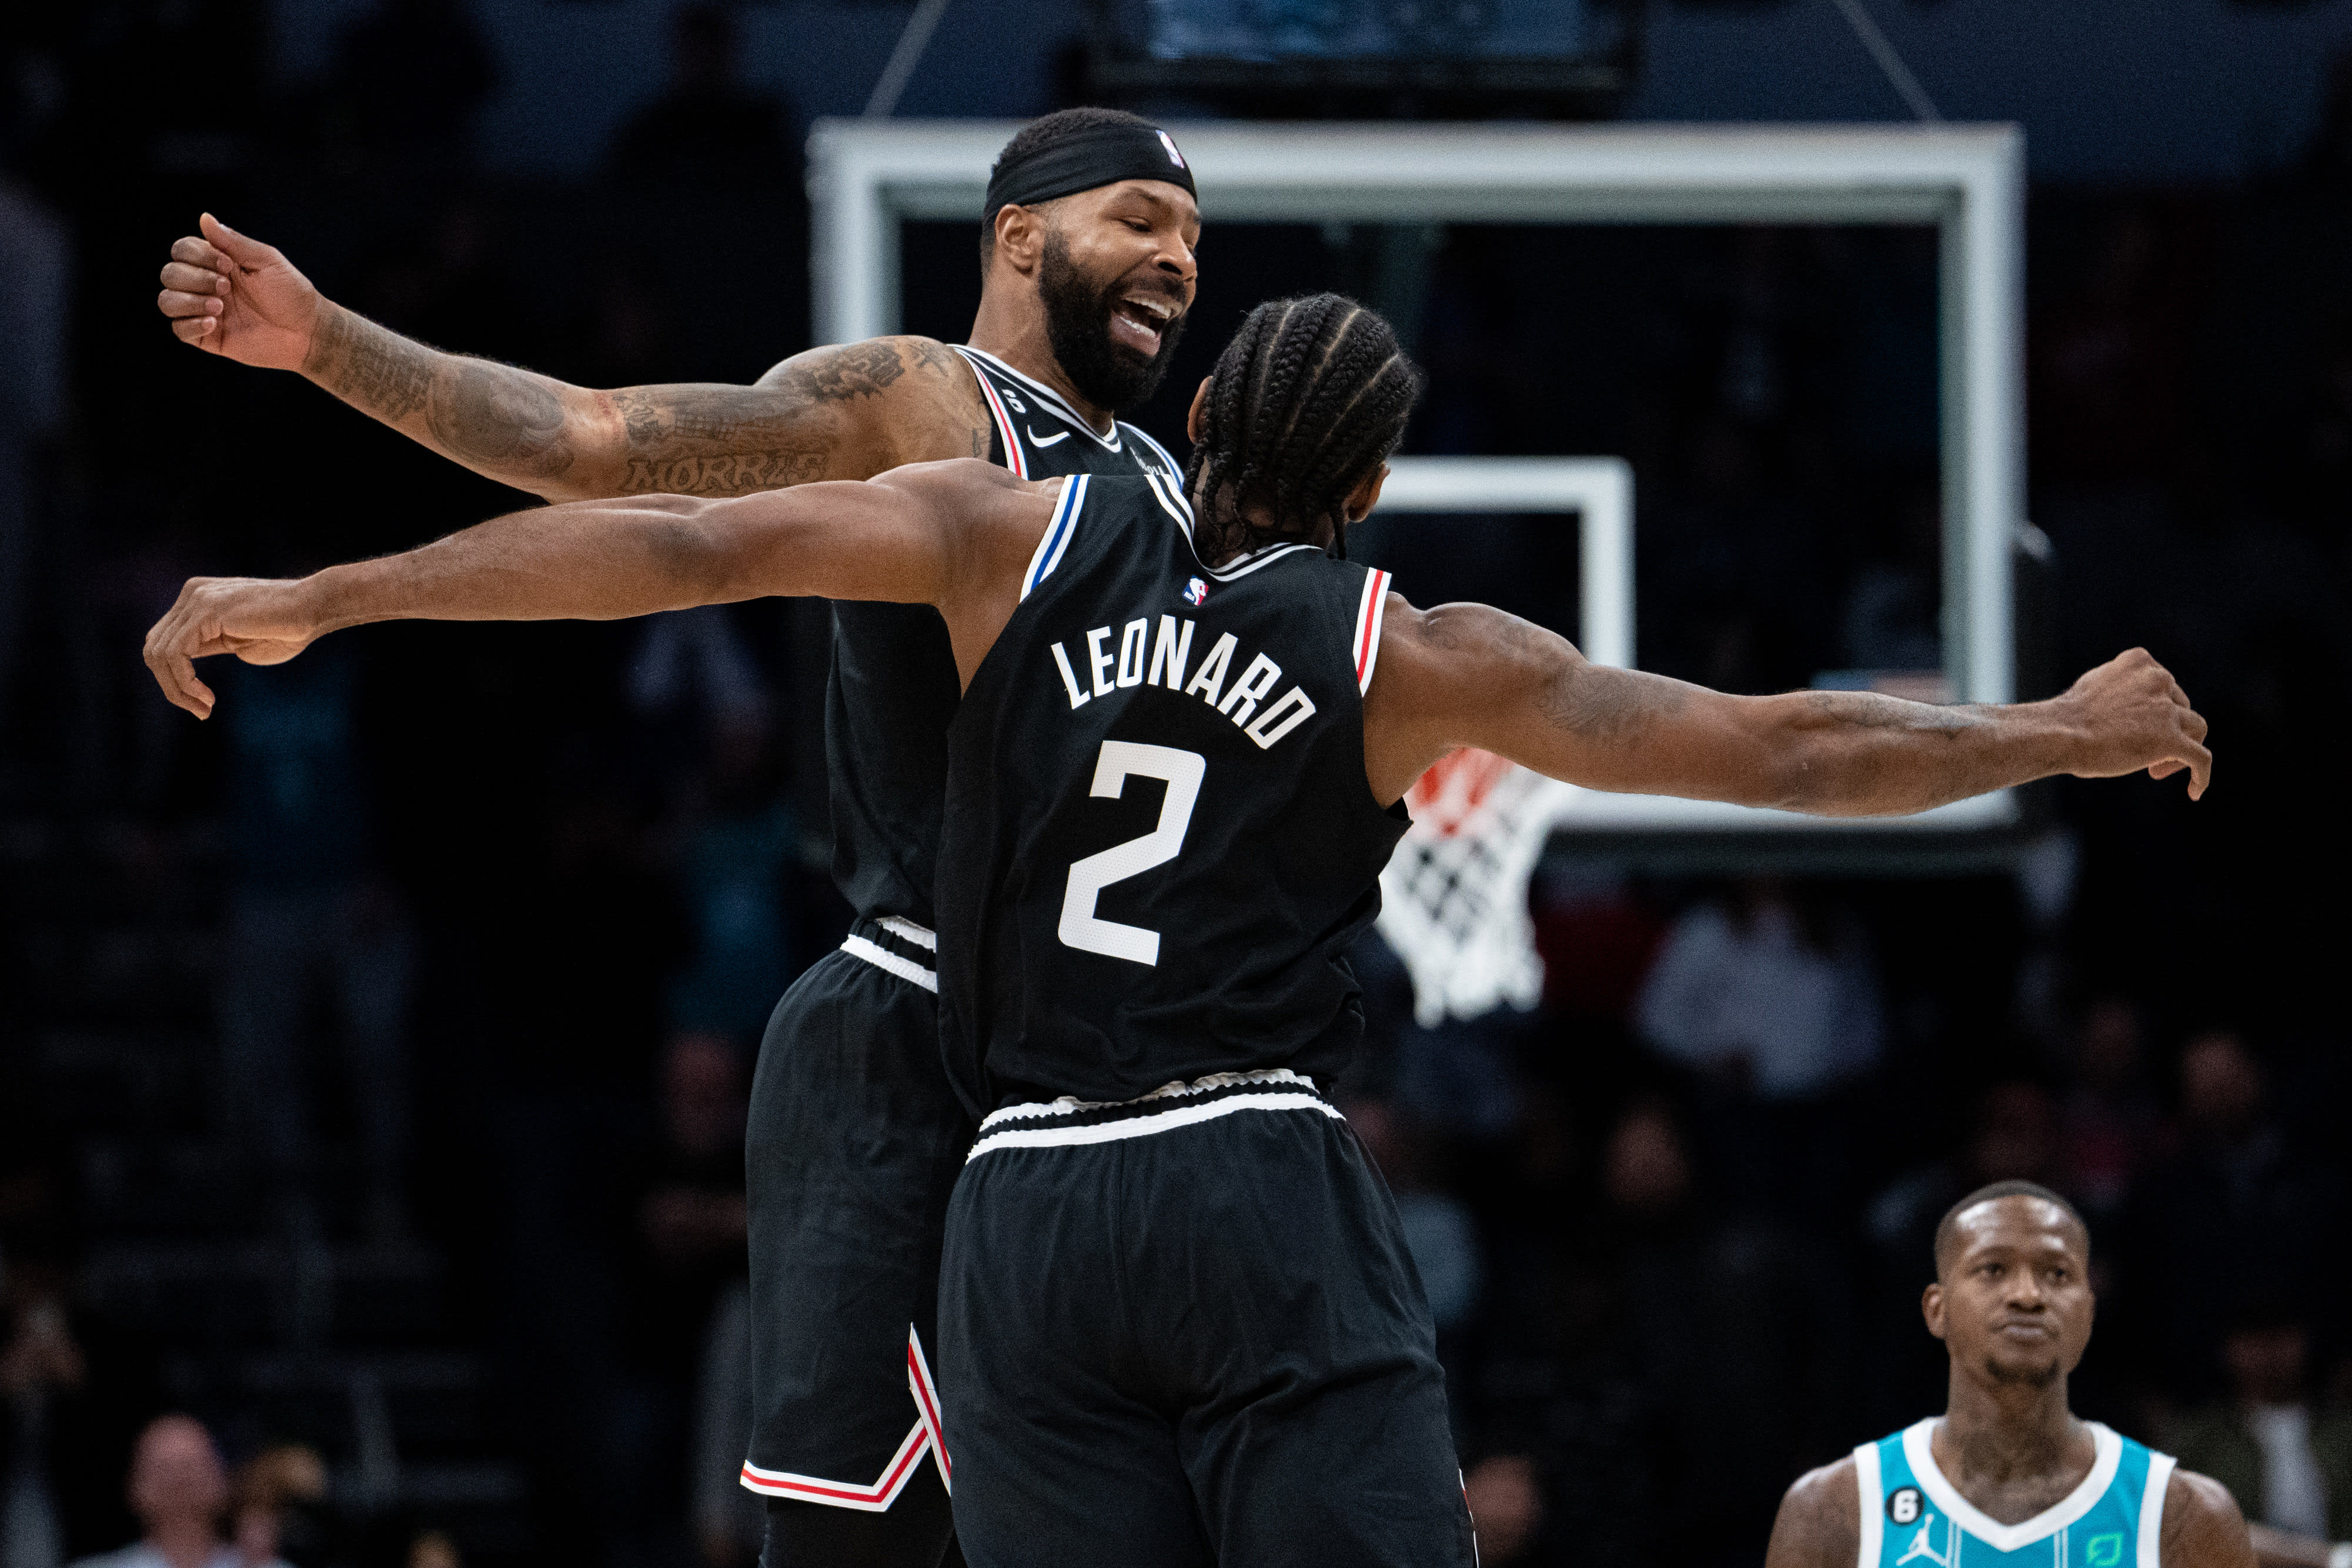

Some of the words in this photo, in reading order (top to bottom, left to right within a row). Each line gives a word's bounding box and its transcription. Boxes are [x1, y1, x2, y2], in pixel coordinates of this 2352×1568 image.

[1184, 591, 1195, 601] NBA
[1050, 614, 1317, 750] LEONARD
[1058, 740, 1207, 967] 2
[1894, 1489, 1918, 1523] 6
